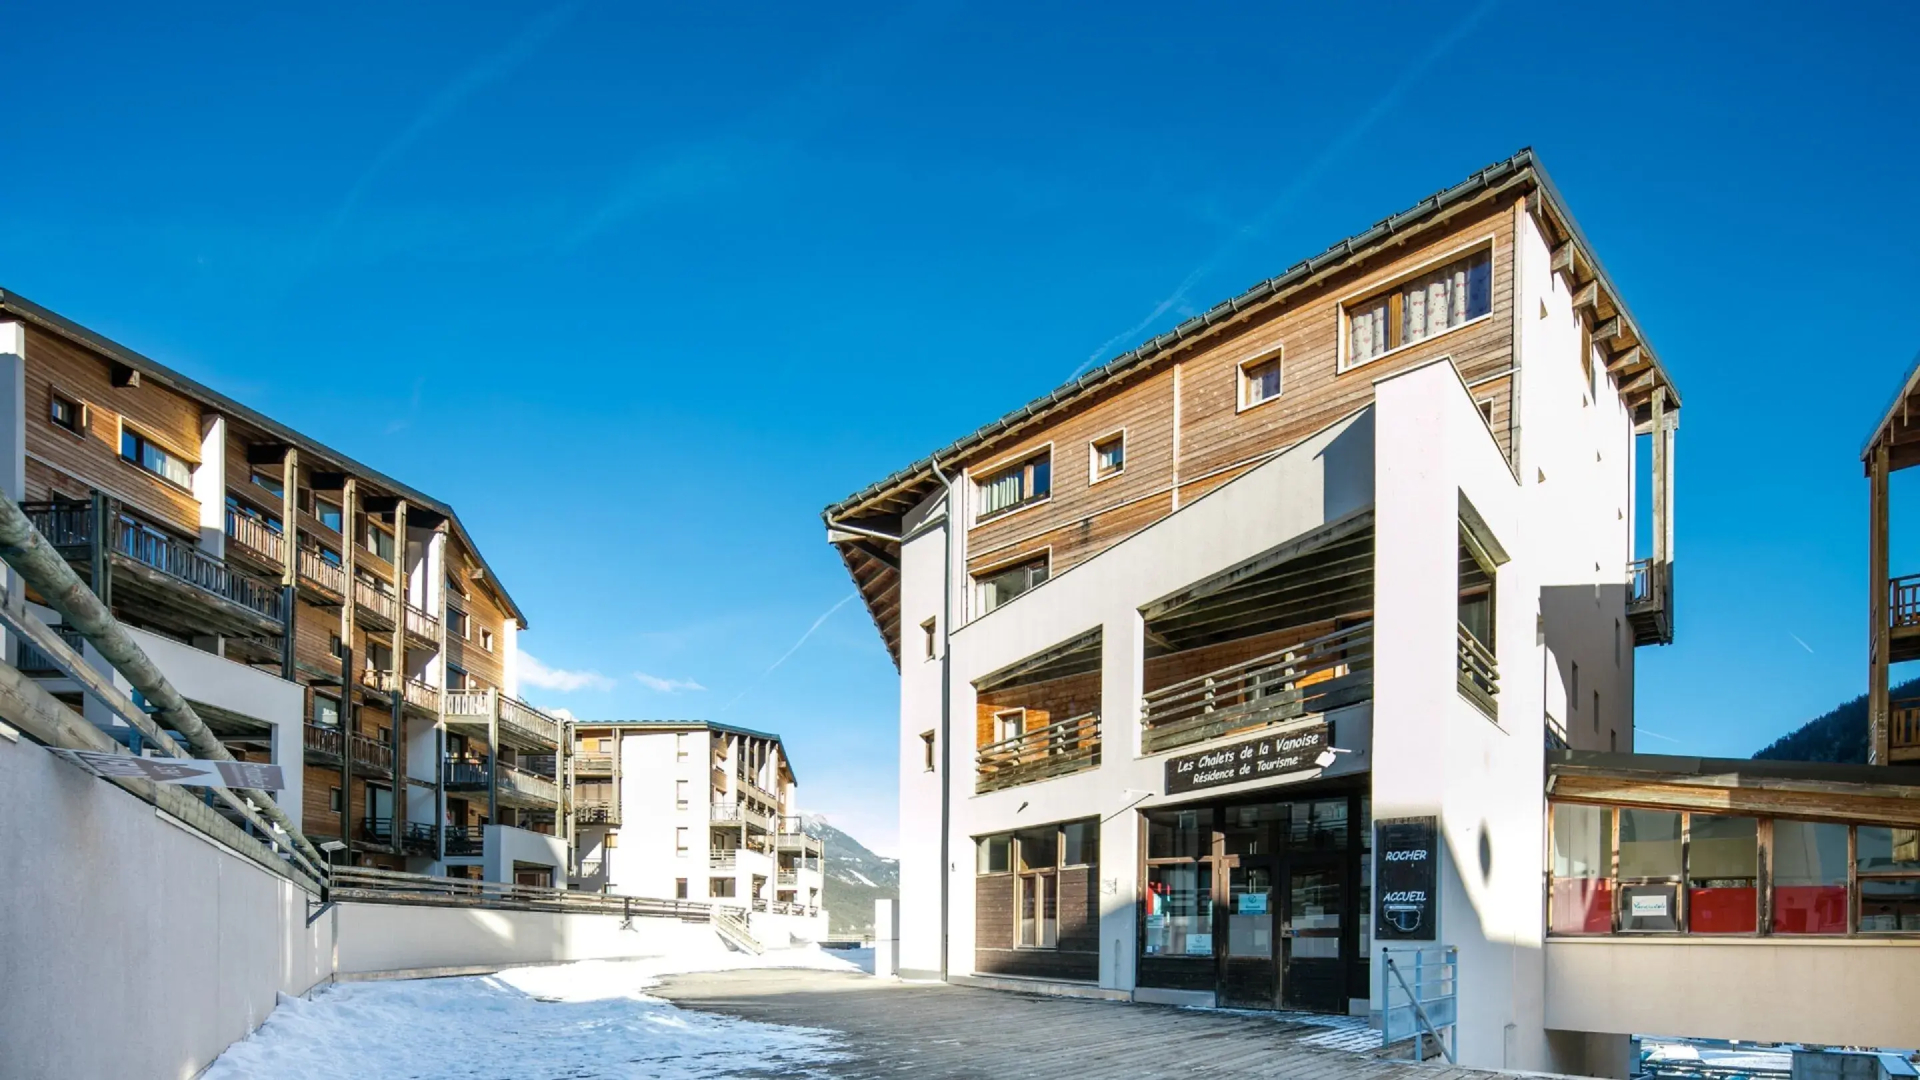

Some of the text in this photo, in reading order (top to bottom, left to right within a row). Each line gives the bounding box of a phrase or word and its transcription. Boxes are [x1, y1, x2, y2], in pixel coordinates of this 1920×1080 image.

[1177, 734, 1318, 773] Les Chalets de la Vanoise
[1193, 756, 1299, 784] Résidence de Tourisme
[1385, 850, 1427, 861] ROCHER
[1383, 891, 1426, 902] ACCUEIL
